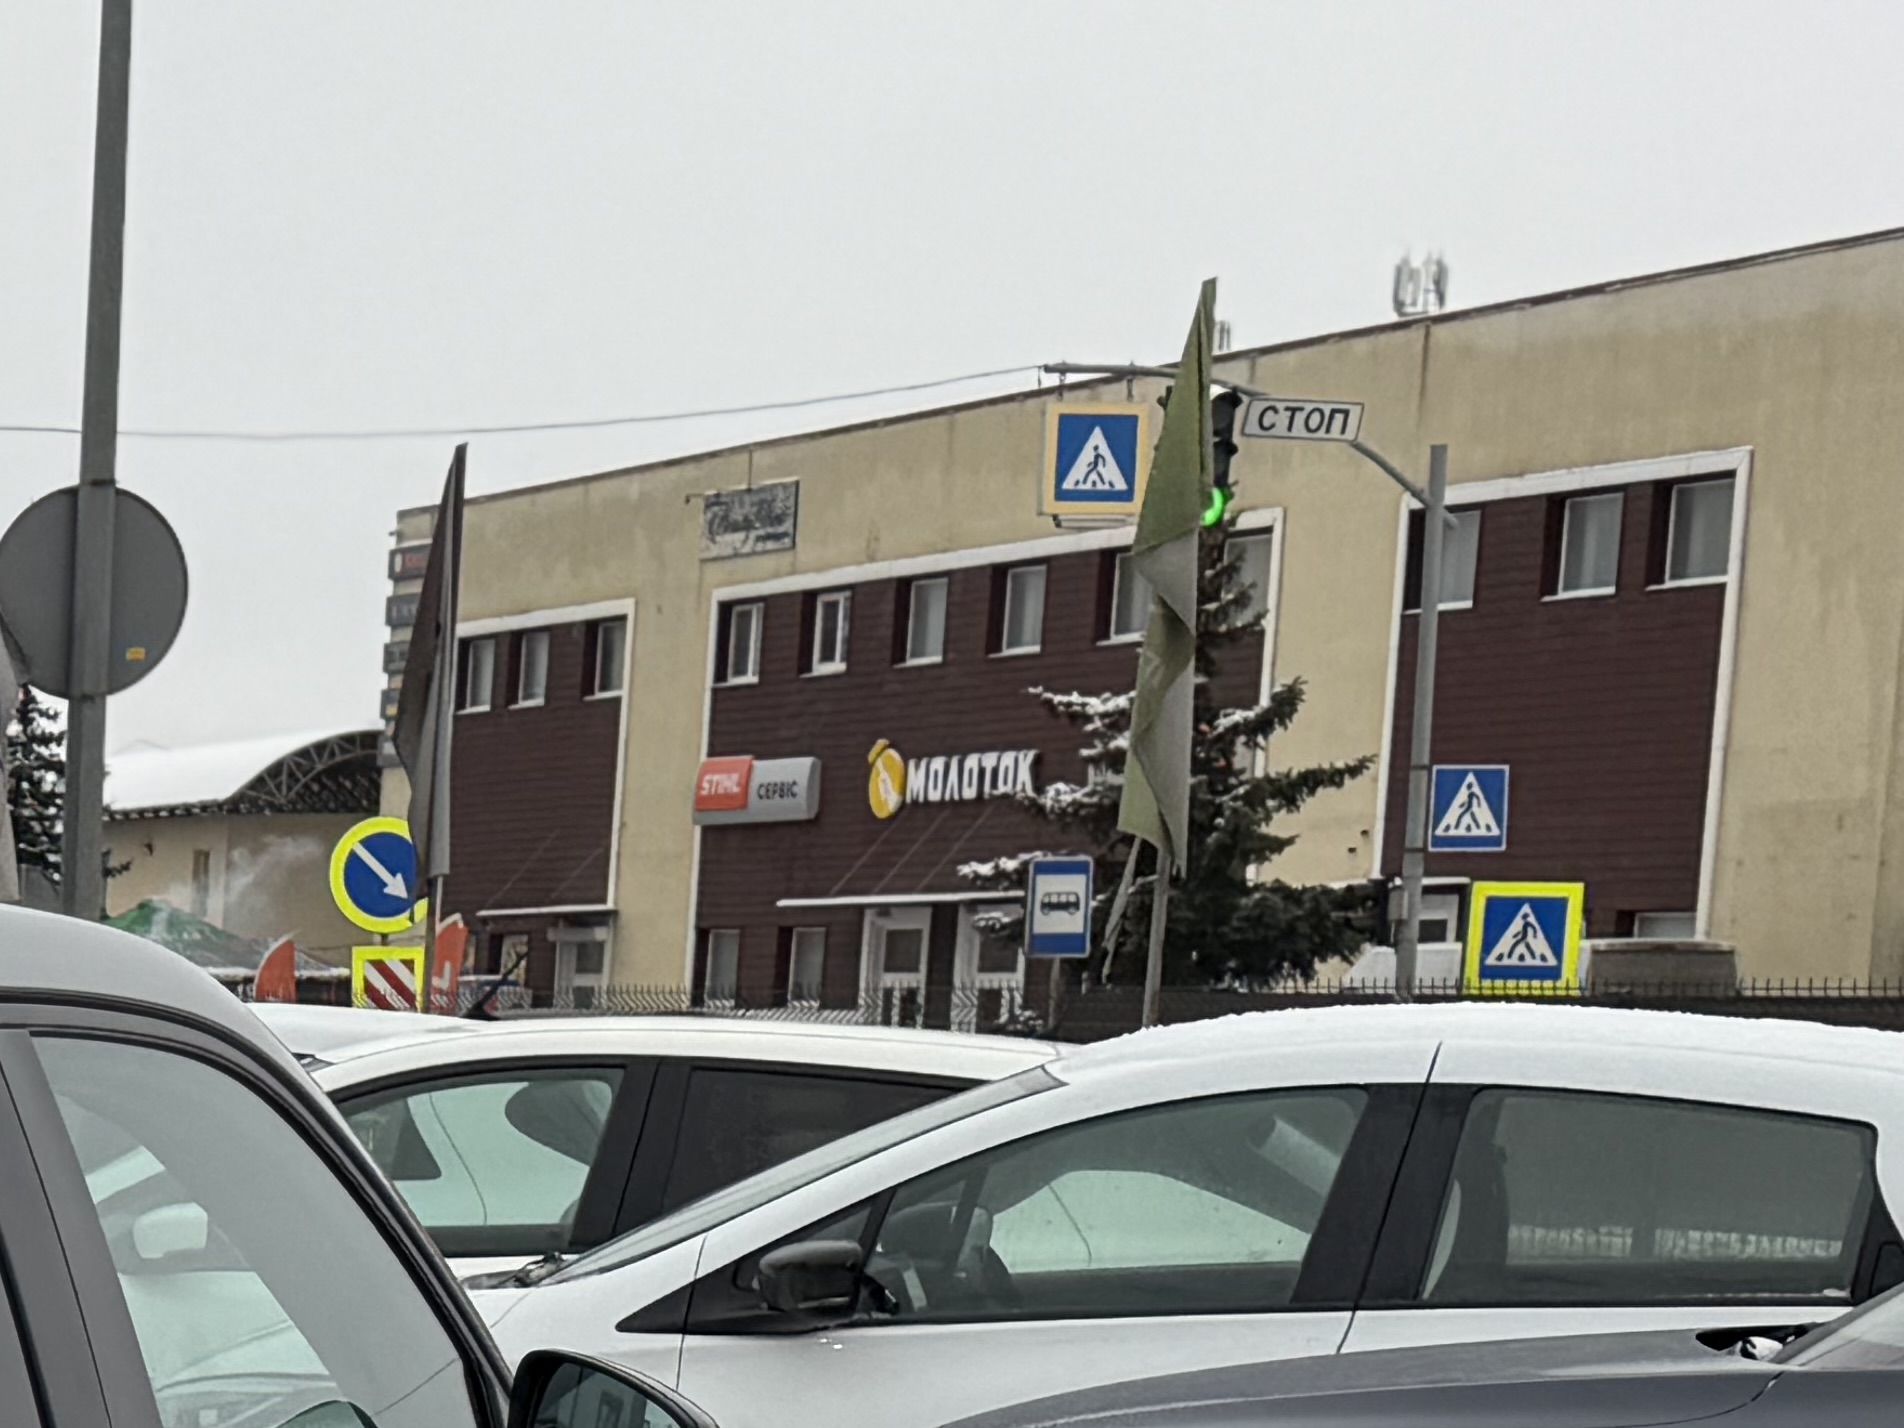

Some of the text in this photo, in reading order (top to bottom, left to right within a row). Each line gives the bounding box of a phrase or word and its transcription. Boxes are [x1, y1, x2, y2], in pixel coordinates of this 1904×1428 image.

[1258, 405, 1351, 435] СТОП
[757, 780, 798, 800] СЕРВІС
[905, 750, 1038, 803] МОЛОТОК
